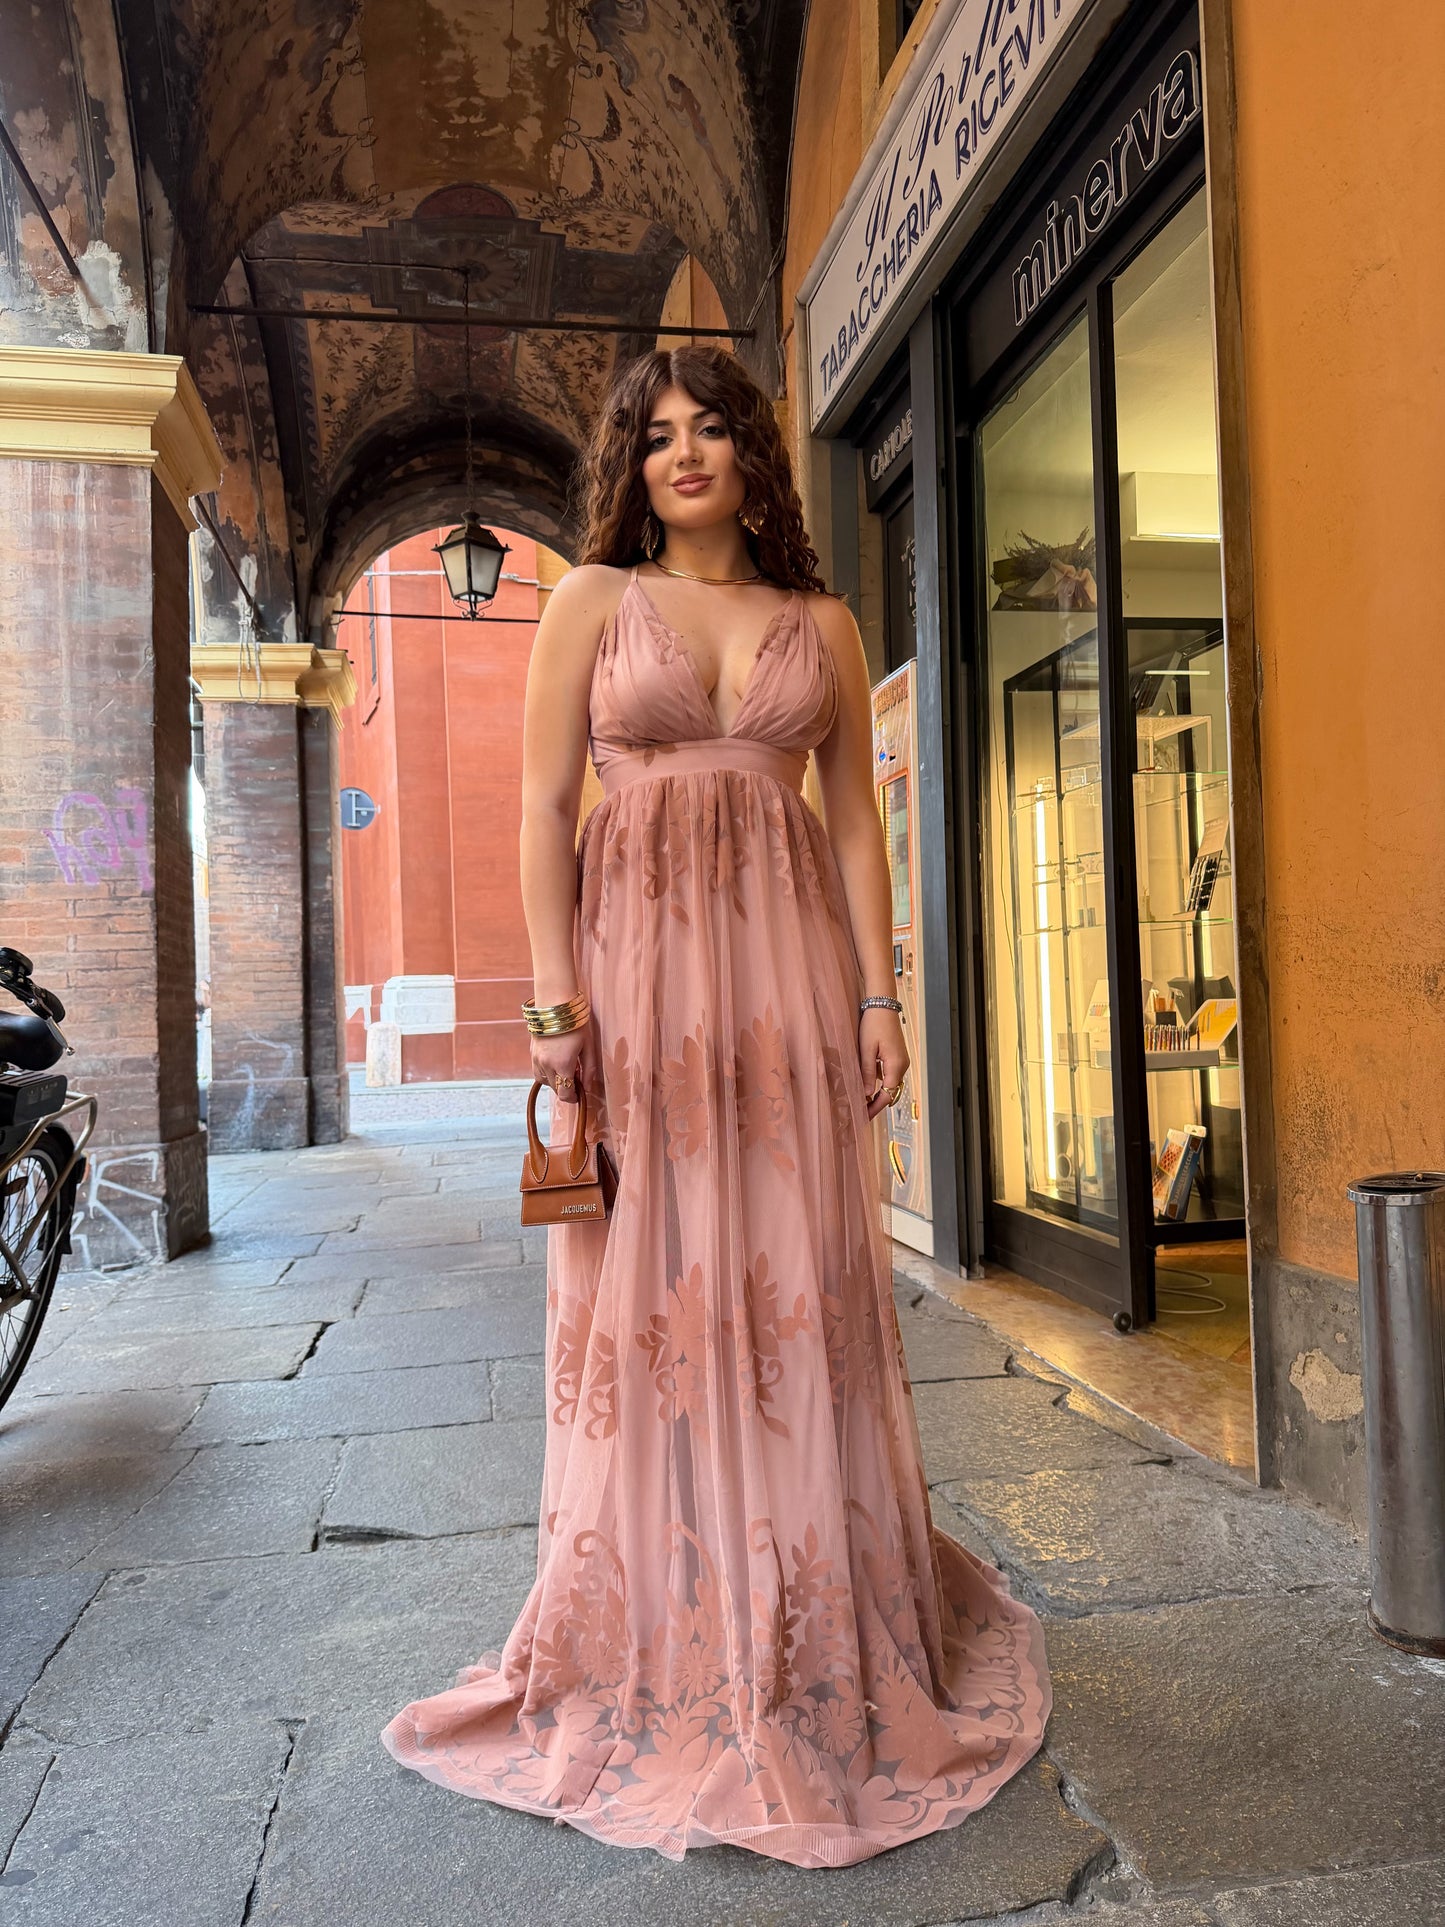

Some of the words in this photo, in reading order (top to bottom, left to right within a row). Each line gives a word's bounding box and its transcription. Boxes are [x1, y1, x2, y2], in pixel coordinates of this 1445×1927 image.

[820, 169, 942, 396] TABACCHERIA
[1012, 50, 1200, 326] minerva
[560, 1203, 597, 1214] JACQUEMUS
